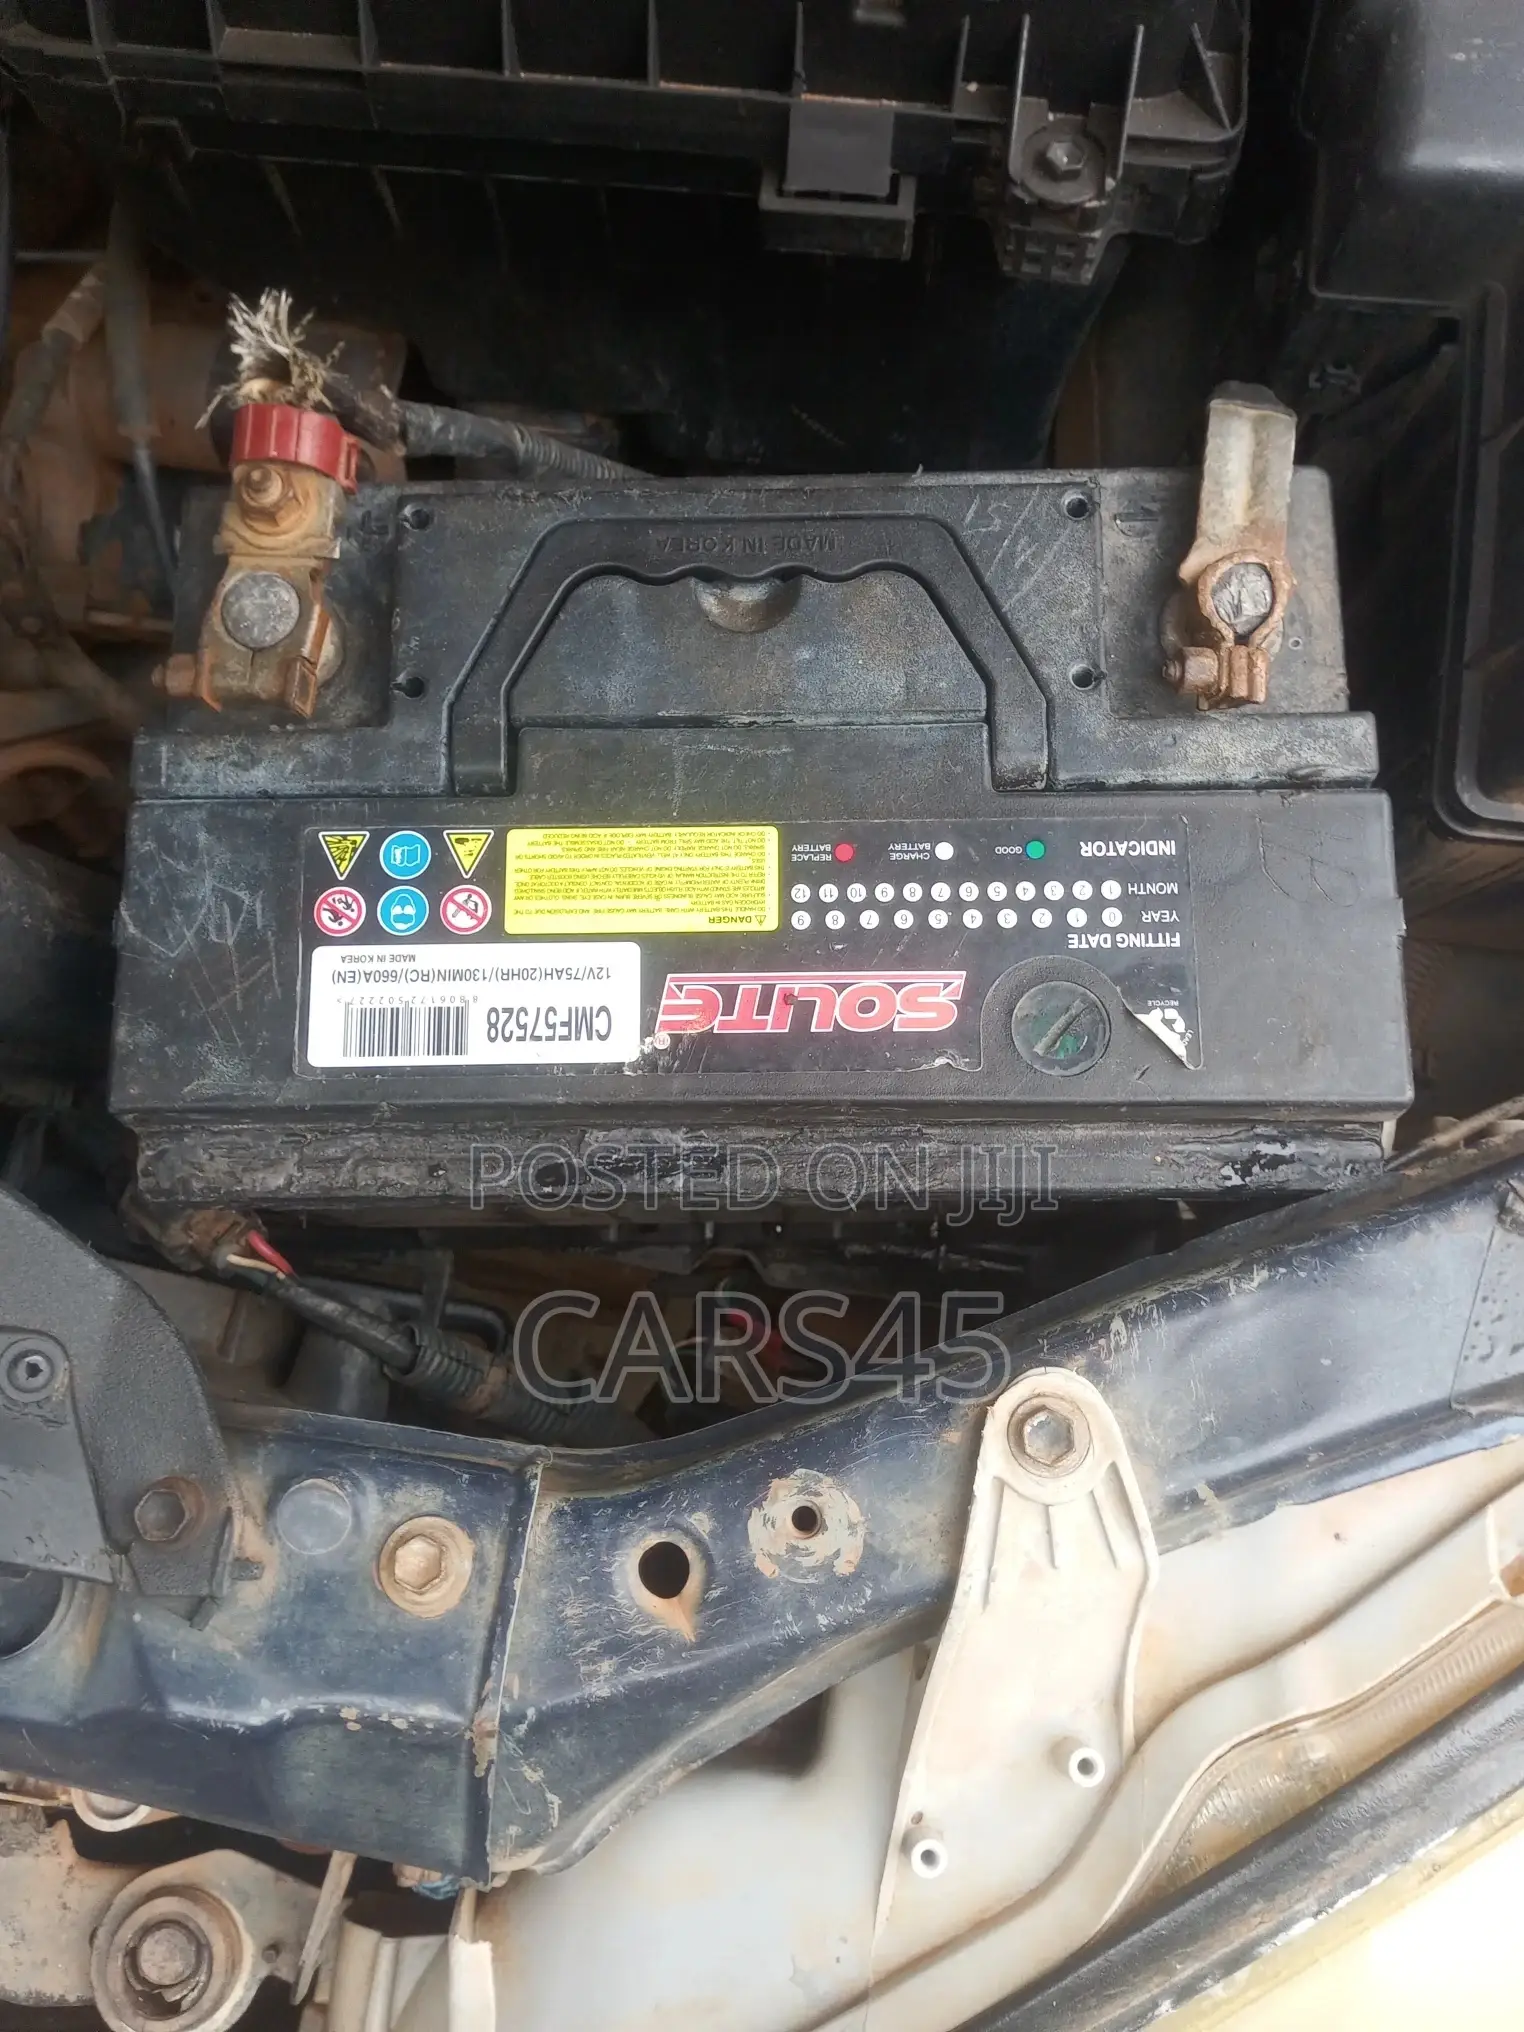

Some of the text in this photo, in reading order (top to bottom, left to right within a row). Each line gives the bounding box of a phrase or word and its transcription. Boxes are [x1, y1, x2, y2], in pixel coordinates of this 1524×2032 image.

[655, 536, 838, 554] MADE IN KOREA
[791, 844, 832, 853] BATTERY
[888, 842, 931, 851] BATTERY
[994, 846, 1023, 855] GOOD
[1080, 840, 1177, 857] INDICATOR
[791, 853, 832, 862] REPLACE
[889, 851, 931, 861] CHARGE
[1127, 882, 1178, 895] MONTH
[708, 915, 752, 924] DANGER
[1140, 910, 1180, 923] YEAR
[1065, 932, 1181, 949] FITTING DATE
[340, 954, 416, 964] MADE IN KOREA
[332, 967, 611, 985] 12V/75AH(20HR)/130MIN(RC)/660A(EN)
[654, 976, 961, 1032] SOLITE
[488, 1006, 611, 1043] CMF57528
